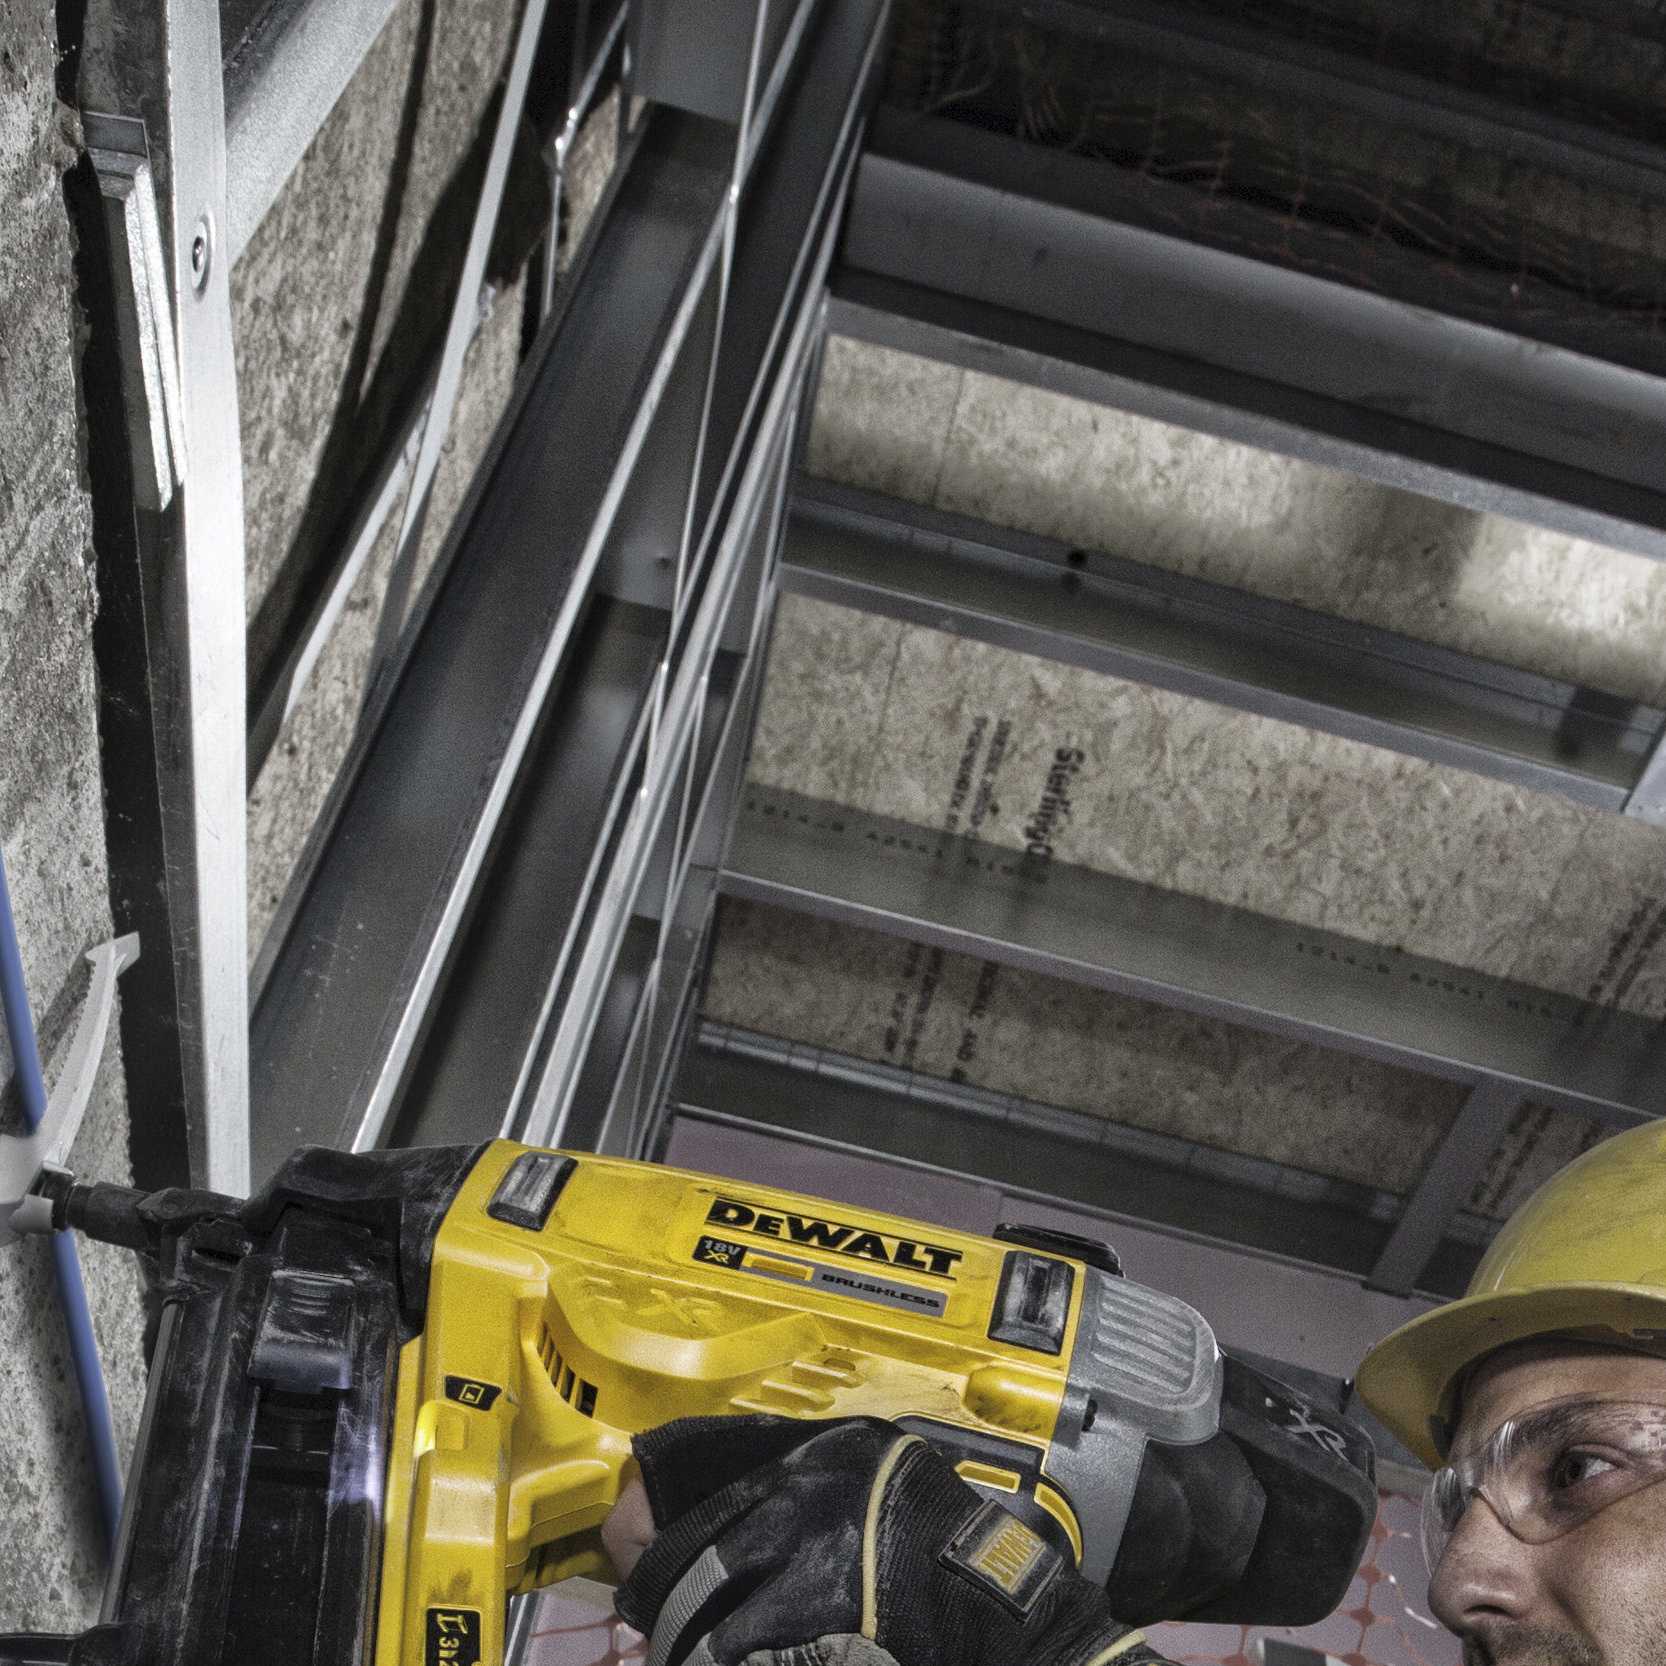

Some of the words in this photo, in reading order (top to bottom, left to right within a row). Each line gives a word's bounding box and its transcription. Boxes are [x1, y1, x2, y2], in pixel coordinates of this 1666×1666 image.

[703, 1238, 742, 1257] 18V
[704, 1198, 963, 1275] DEWALT
[704, 1250, 731, 1265] XR
[821, 1273, 940, 1308] BRUSHLESS
[1284, 1408, 1350, 1462] XR
[439, 1637, 460, 1649] 3
